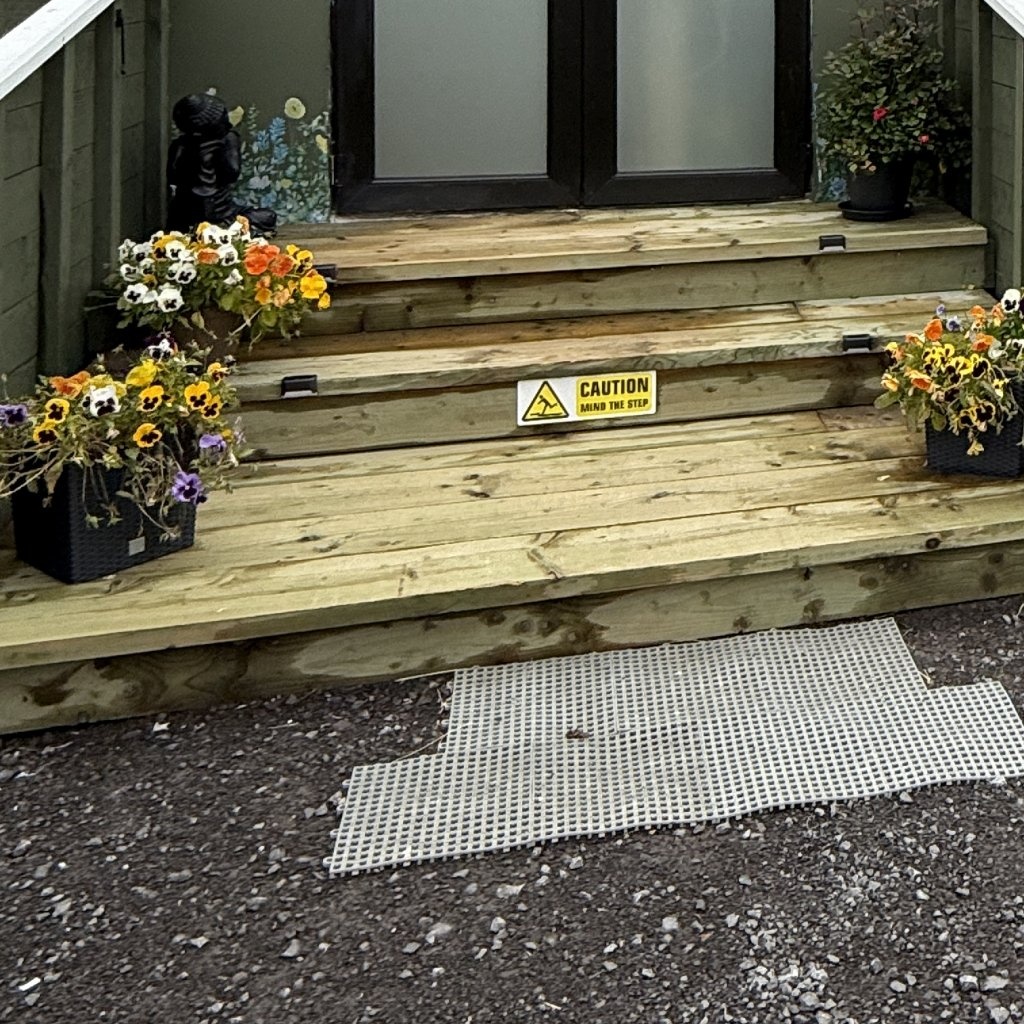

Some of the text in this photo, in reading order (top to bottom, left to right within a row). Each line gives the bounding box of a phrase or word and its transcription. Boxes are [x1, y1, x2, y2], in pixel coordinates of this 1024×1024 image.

[580, 377, 649, 398] CAUTION
[580, 398, 649, 413] MIND THE STEP
